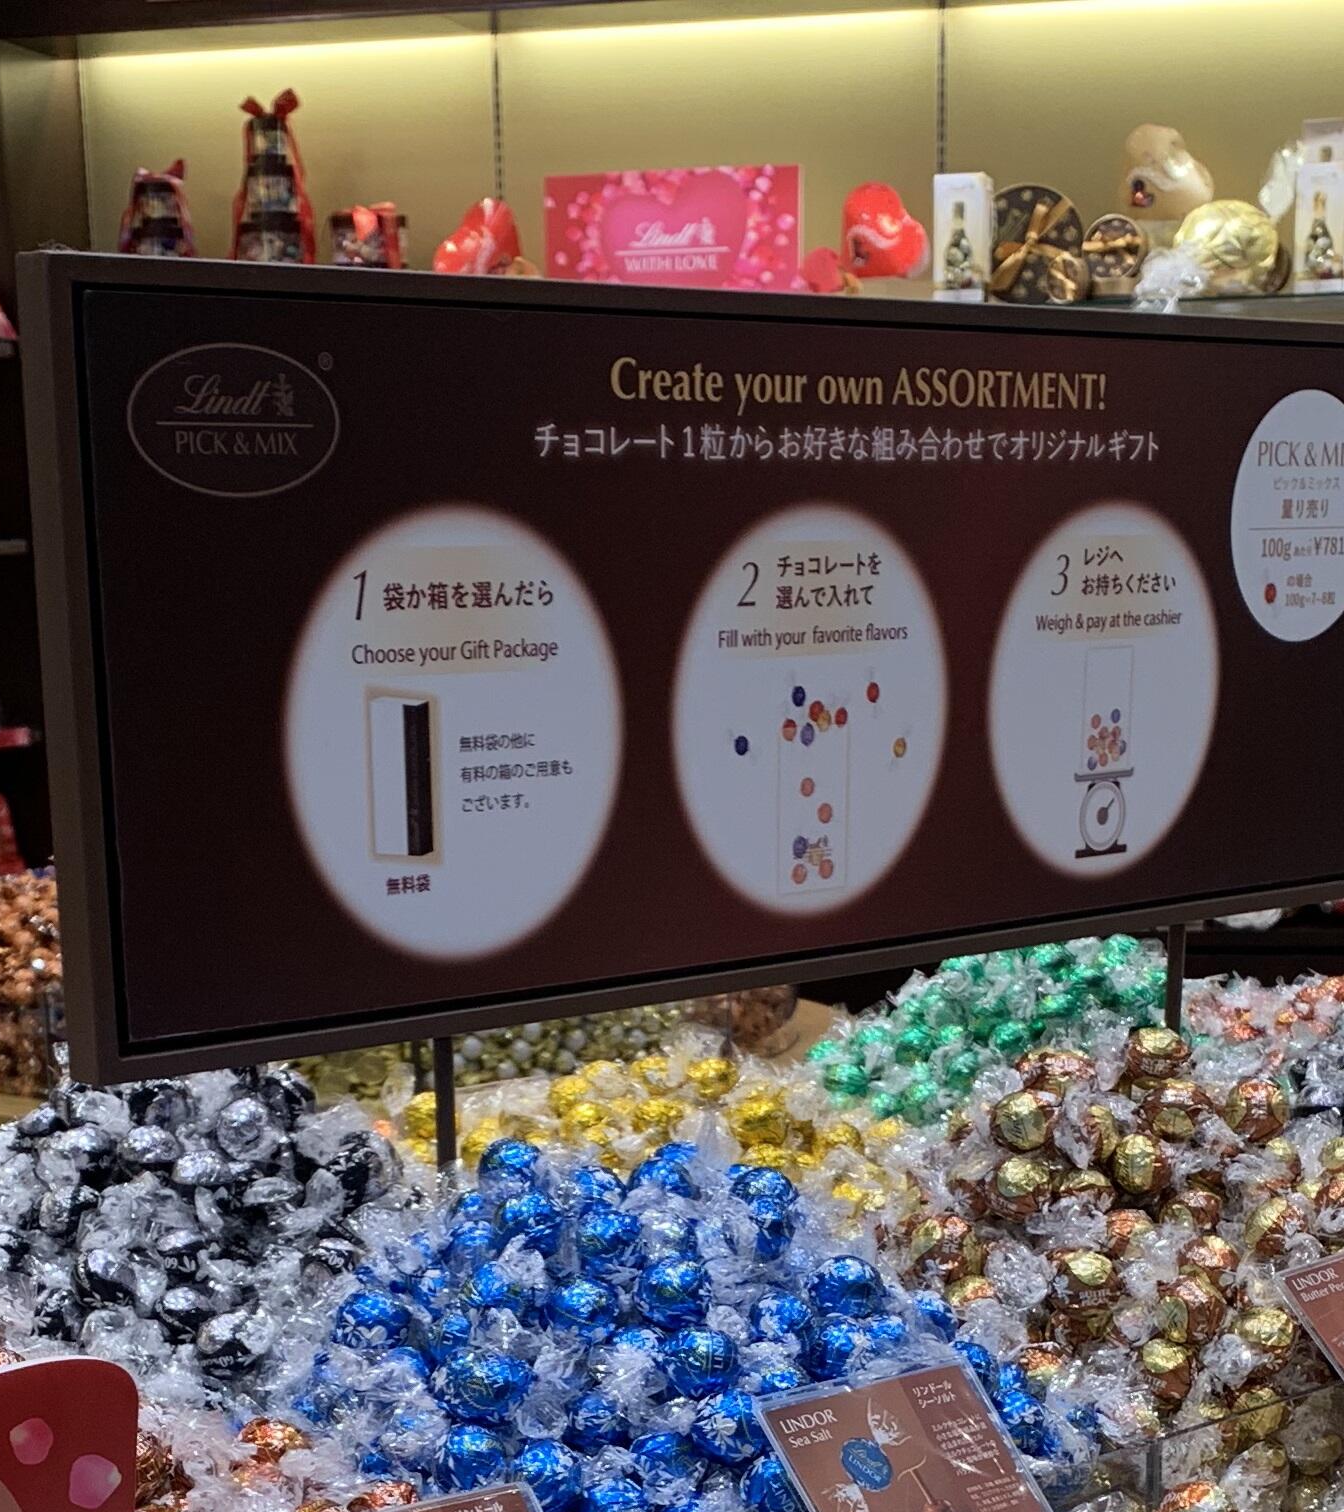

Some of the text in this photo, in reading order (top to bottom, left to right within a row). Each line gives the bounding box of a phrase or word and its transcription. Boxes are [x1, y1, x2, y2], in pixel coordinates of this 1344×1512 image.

[628, 220, 700, 247] Lindt
[623, 254, 718, 273] WITH LOVE
[174, 374, 273, 416] Lindt
[610, 356, 1107, 416] Create your own ASSORTMENT!
[175, 431, 299, 456] PICK & MIX
[1257, 440, 1301, 467] PICK
[1304, 441, 1317, 467] &
[776, 552, 883, 578] チョコレートを
[1083, 545, 1124, 567] レジへ
[736, 561, 760, 607] 2
[1050, 554, 1070, 596] 3
[1081, 573, 1177, 597] お持ちください
[352, 570, 368, 620] 1
[383, 580, 554, 611] 袋か箱を選んだら
[775, 584, 875, 610] 選んで入れて
[1035, 608, 1183, 635] Weigh & pay at the cashier
[718, 622, 908, 650] Fill with your favorite flavors
[351, 638, 559, 667] Choose your Gift Package
[459, 732, 536, 753] 無料袋の他に
[460, 760, 573, 783] 有料の箱のご用意も
[461, 792, 531, 813] ございます。
[386, 874, 432, 897] 無料袋
[1291, 1266, 1340, 1292] LINDOR
[1299, 1287, 1329, 1303] Butter
[911, 1380, 953, 1399] リンドール
[779, 1407, 838, 1435] LINDOR
[788, 1427, 833, 1450] Sea Salt
